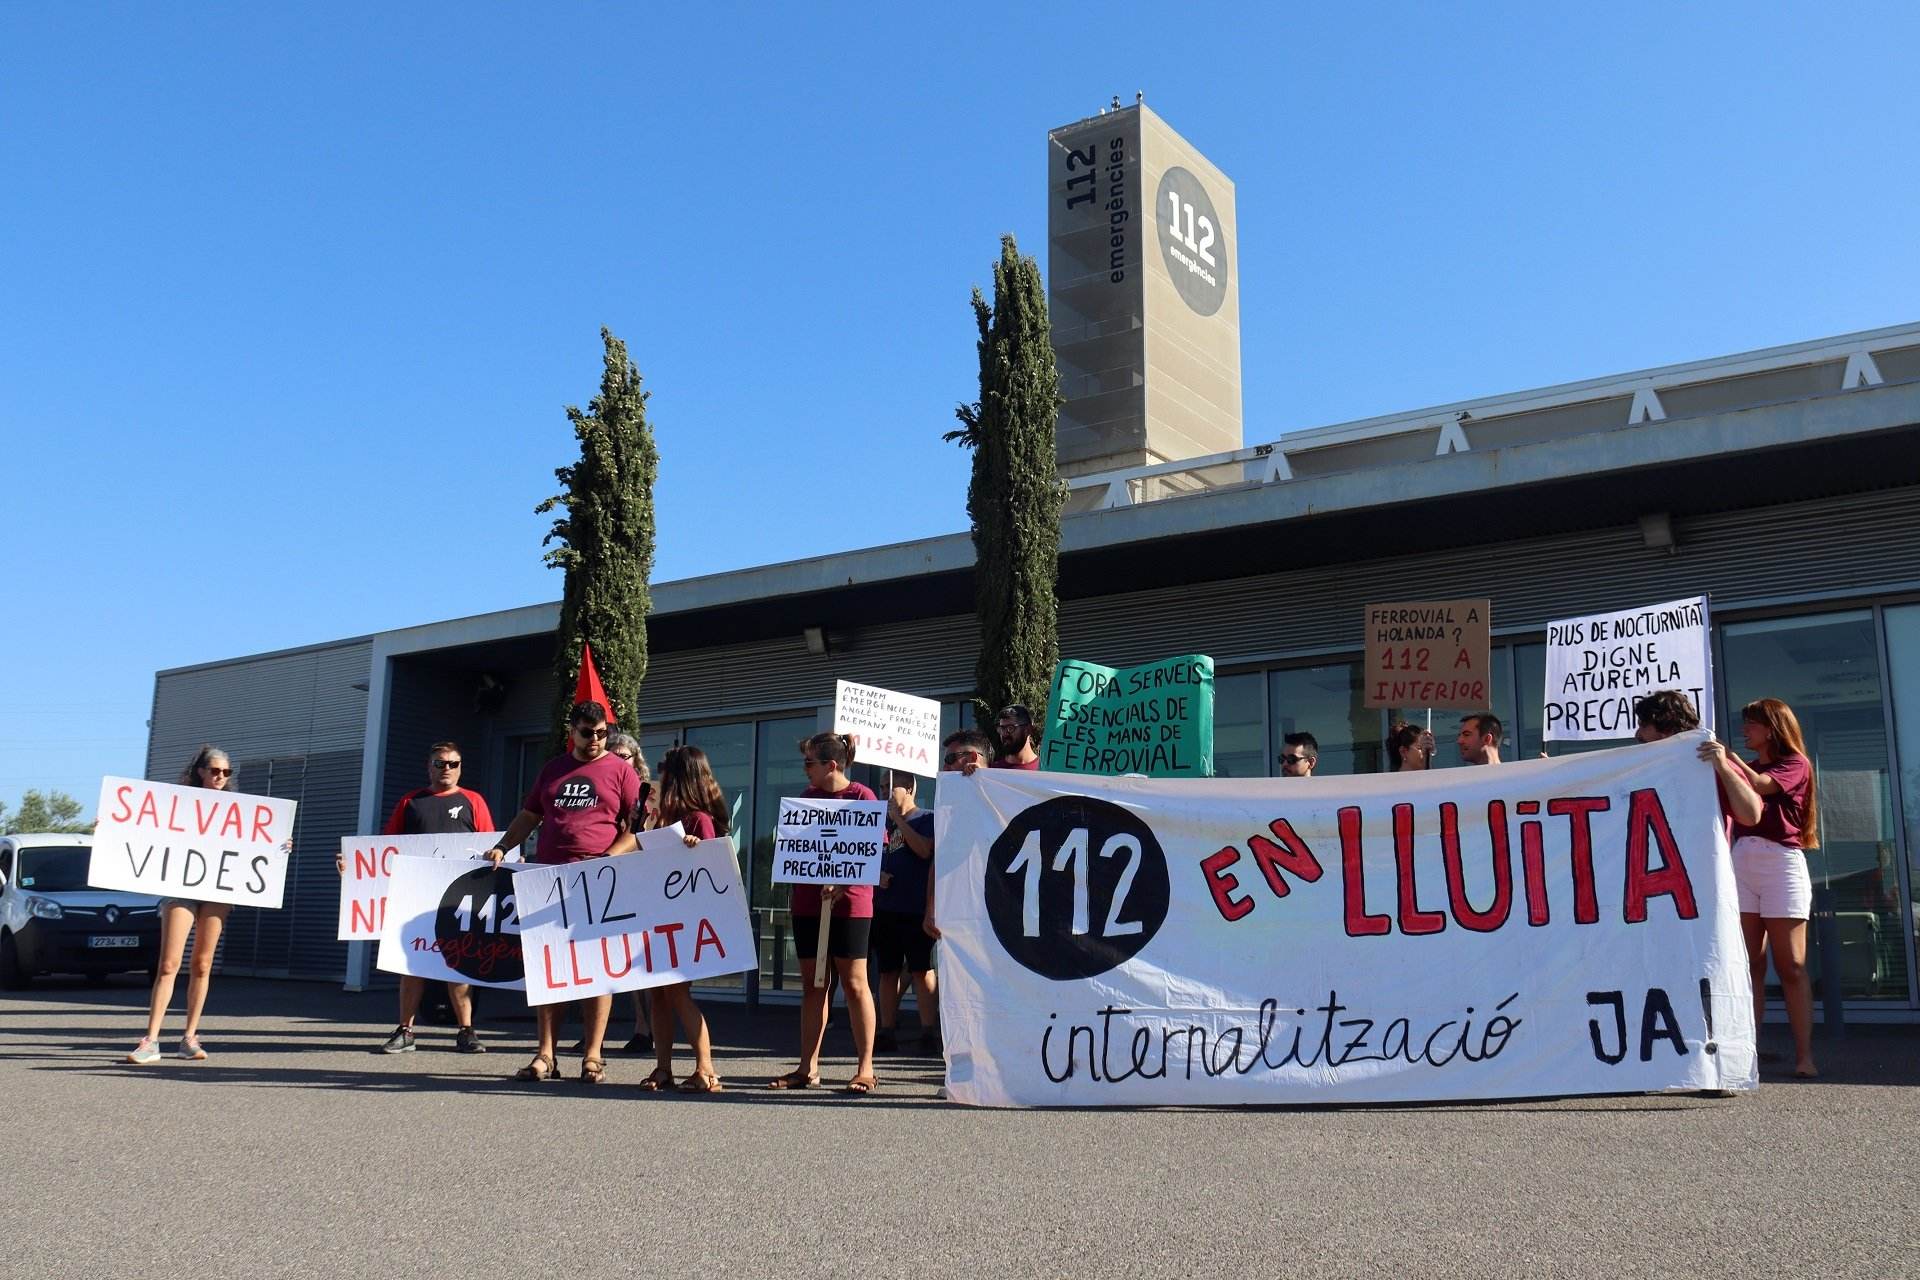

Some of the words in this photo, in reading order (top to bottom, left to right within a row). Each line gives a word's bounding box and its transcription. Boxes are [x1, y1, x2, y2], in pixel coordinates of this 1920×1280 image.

[1066, 145, 1097, 210] 112
[1105, 136, 1129, 284] emergències
[1168, 191, 1216, 268] 112
[1170, 246, 1216, 288] emergències
[1371, 608, 1455, 625] FERROVIAL
[1466, 607, 1479, 624] A
[1549, 622, 1584, 647] PLUS
[1590, 621, 1609, 643] DE
[1613, 602, 1705, 640] NOCTURNITAT
[1377, 626, 1445, 643] HOLANDA
[1381, 647, 1431, 672] 112
[1454, 647, 1471, 670] A
[1583, 642, 1658, 672] DIGNE
[844, 686, 887, 701] ATENEM
[1057, 665, 1122, 699] FORA
[1128, 659, 1205, 696] SERVEIS
[1373, 680, 1484, 701] INTERIOR
[1563, 666, 1650, 695] ATUREM
[1657, 660, 1681, 684] LA
[839, 714, 887, 730] ALEMANY
[897, 725, 912, 736] PER
[918, 730, 937, 742] UNA
[923, 712, 938, 721] EN
[1057, 698, 1161, 728] ESSENCIALS
[1166, 697, 1189, 721] DE
[1063, 725, 1097, 745] LES
[1107, 726, 1151, 745] MANS
[1160, 724, 1182, 742] DE
[1047, 739, 1192, 773] FERROVIAL
[554, 797, 567, 808] EN
[563, 783, 590, 797] 112
[111, 785, 274, 844] SALVAR
[778, 839, 878, 857] TREBALLADORES
[818, 853, 831, 862] EN
[1005, 826, 1144, 938] 112
[1200, 817, 1324, 922] EN
[1337, 787, 1700, 937] LLUITA
[125, 841, 270, 895] VIDES
[783, 860, 867, 879] PRECARIETAT
[546, 864, 637, 930] 112
[664, 865, 729, 900] en
[454, 894, 521, 936] 112
[543, 918, 726, 990] LLUITA
[1041, 990, 1524, 1084] internalització
